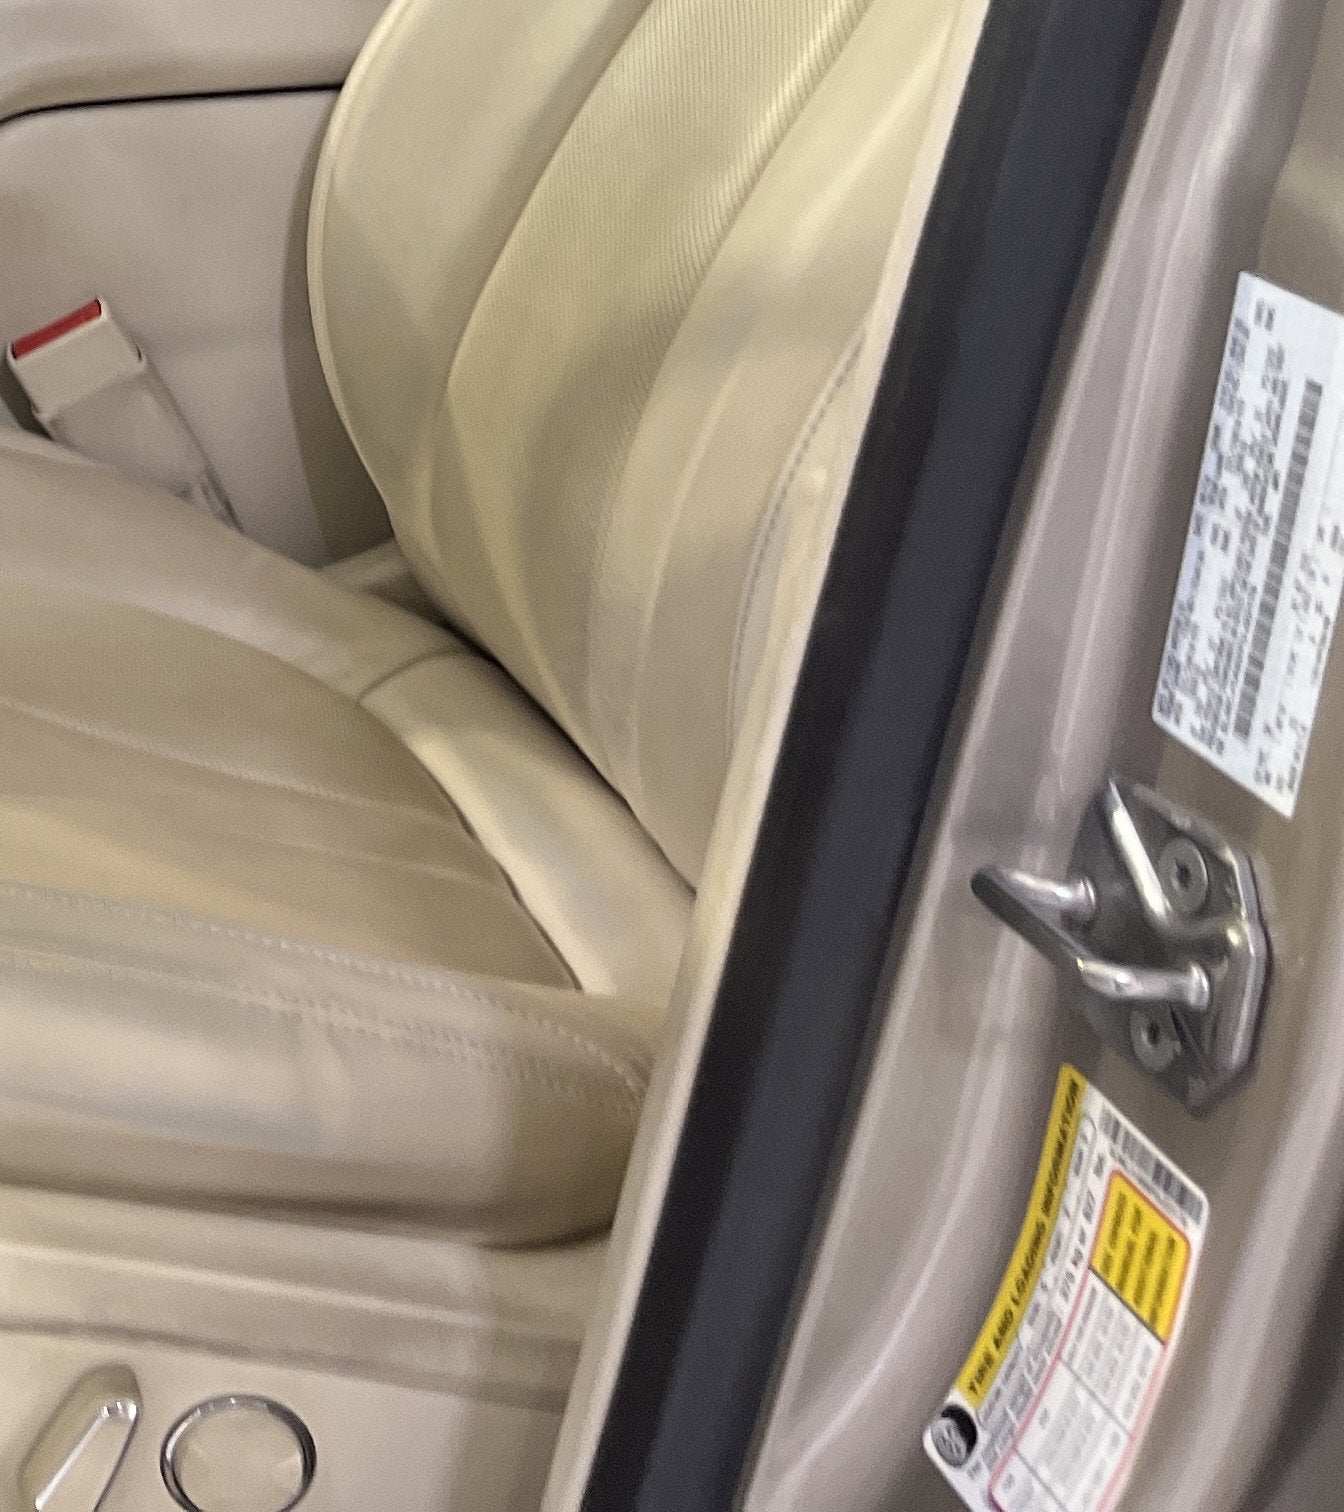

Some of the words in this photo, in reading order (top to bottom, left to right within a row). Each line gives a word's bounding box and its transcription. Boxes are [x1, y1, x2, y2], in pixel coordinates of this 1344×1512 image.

[968, 1349, 995, 1395] TIRE
[993, 1308, 1014, 1351] AND
[1010, 1220, 1047, 1306] LOADING
[1041, 1078, 1079, 1218] INFORMATION
